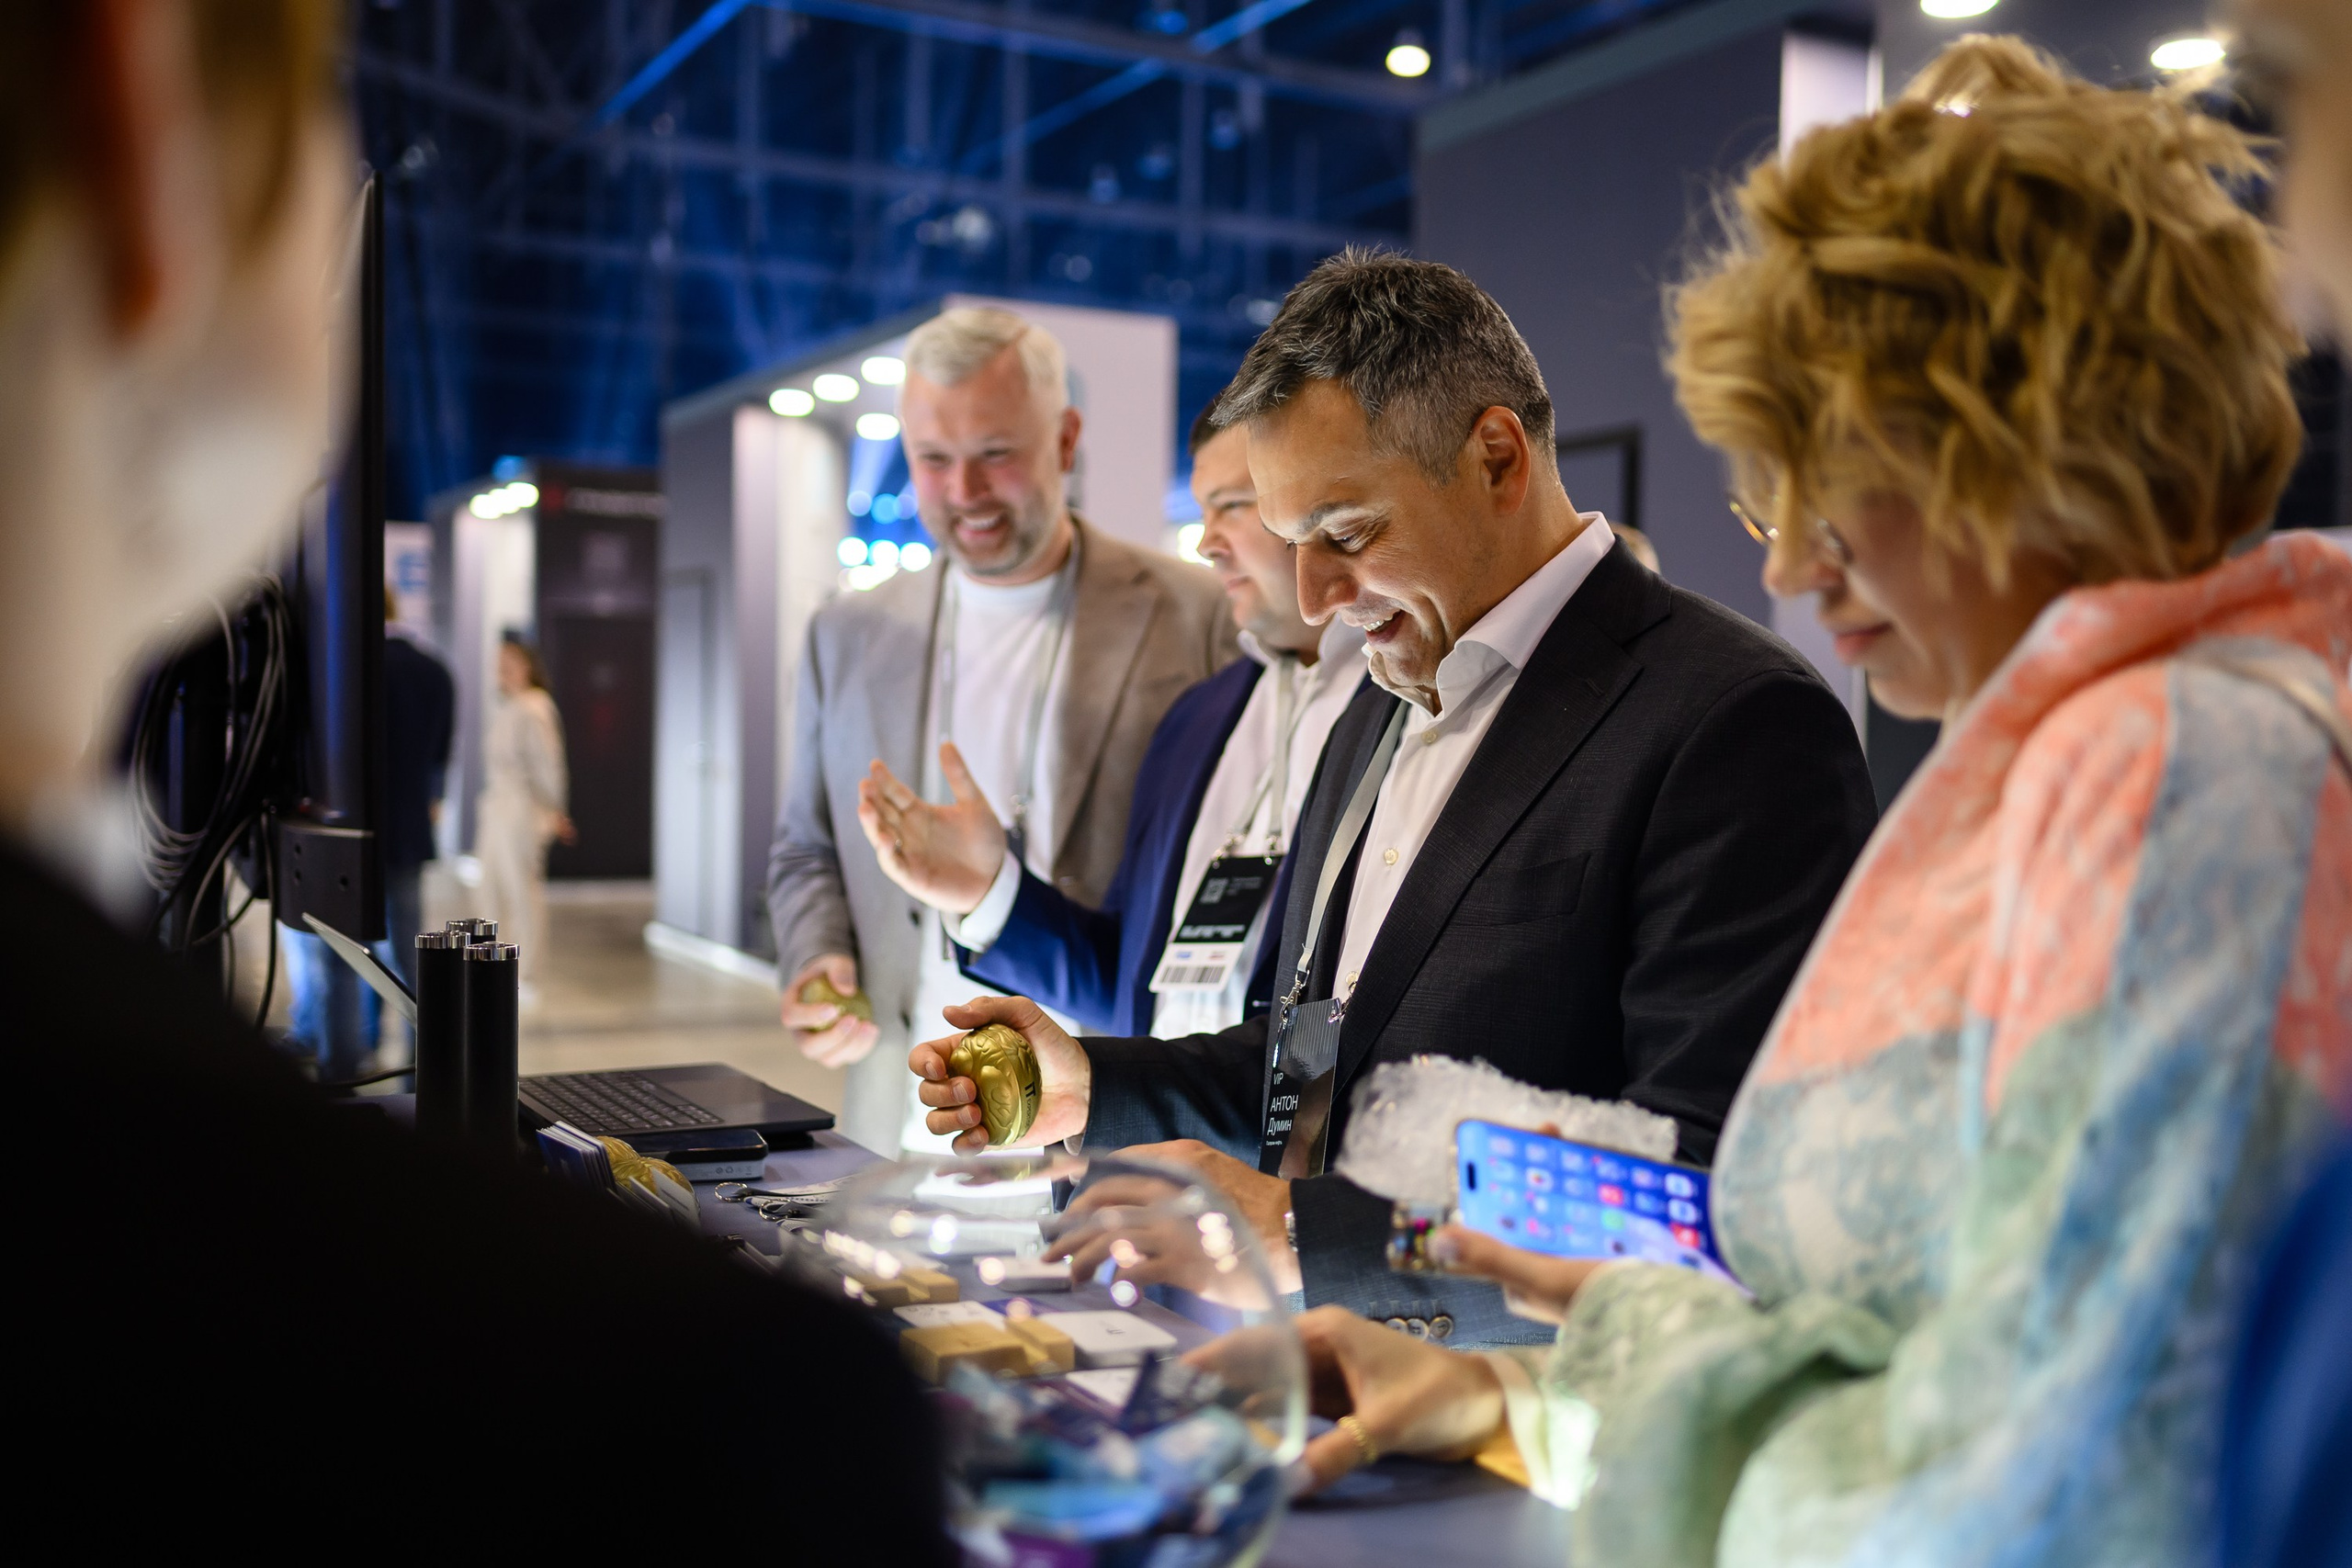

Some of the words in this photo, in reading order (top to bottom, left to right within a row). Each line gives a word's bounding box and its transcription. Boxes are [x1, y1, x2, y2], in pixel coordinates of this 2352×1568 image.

[1273, 1072, 1284, 1085] VIP
[1270, 1095, 1298, 1112] АНТОН
[1267, 1117, 1292, 1135] Думин
